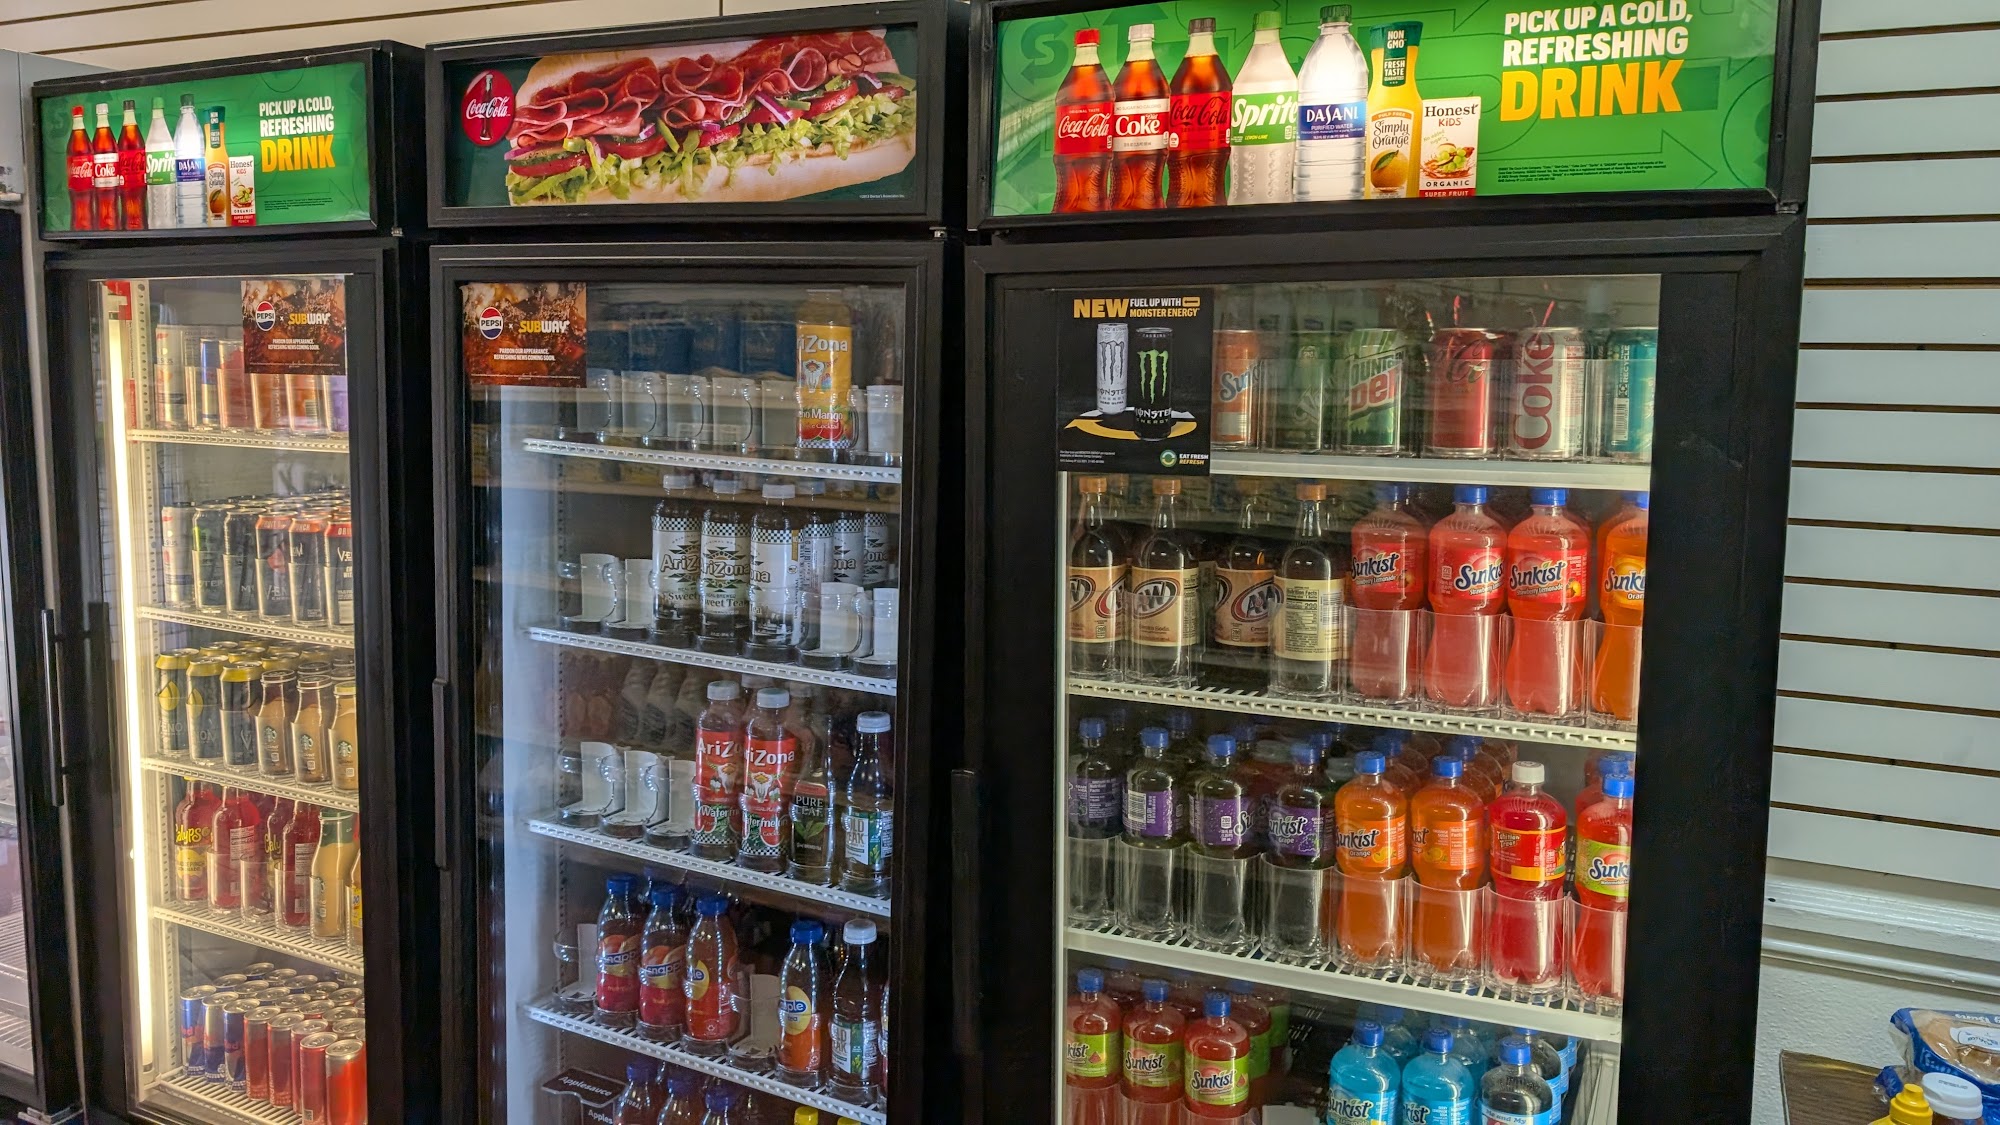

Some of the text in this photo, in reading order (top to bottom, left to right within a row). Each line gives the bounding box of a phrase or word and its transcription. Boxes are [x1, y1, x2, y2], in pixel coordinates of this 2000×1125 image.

[1504, 0, 1693, 35] PICK UP A COLD,
[1387, 40, 1405, 49] GMO
[1388, 30, 1404, 40] NON
[1502, 26, 1689, 67] REFRESHING
[1384, 60, 1406, 69] FRESH
[1385, 68, 1404, 77] TASTE
[1500, 59, 1684, 122] DRINK
[259, 96, 334, 117] PICK UP A COLD,
[466, 96, 511, 119] Coca-Cola
[1231, 95, 1297, 133] Sprite
[1307, 105, 1358, 124] DASANI
[1424, 104, 1479, 117] Honest
[260, 113, 334, 137] REFRESHING
[1058, 113, 1111, 138] Coca-Cola
[1116, 115, 1160, 135] Coke
[1373, 120, 1409, 136] Simply
[1373, 135, 1408, 150] Orange
[261, 134, 335, 173] DRINK
[94, 163, 116, 178] Coke
[146, 153, 175, 177] Sprite
[1073, 298, 1129, 318] NEW
[1130, 298, 1181, 307] FUEL UP WITH
[1130, 308, 1198, 317] MONSTER ENERGY
[288, 313, 331, 325] SUBWAY
[518, 320, 570, 333] SUBWAY
[796, 333, 848, 353] riZona
[1514, 330, 1555, 449] Coke
[812, 408, 843, 422] Mango
[660, 554, 701, 573] AriZ
[701, 560, 750, 578] riZona
[1454, 559, 1503, 591] Sunkis
[1510, 561, 1567, 590] Sunkist
[1605, 566, 1645, 593] Sunki
[704, 599, 725, 607] weet
[795, 796, 823, 808] PURE
[264, 833, 282, 854] Caly
[1588, 857, 1630, 880] Sunk
[1125, 1051, 1166, 1071] Sunkist
[558, 1075, 612, 1097] Applesauce
[1191, 1069, 1237, 1089] Sunkist
[588, 1109, 614, 1124] Apples
